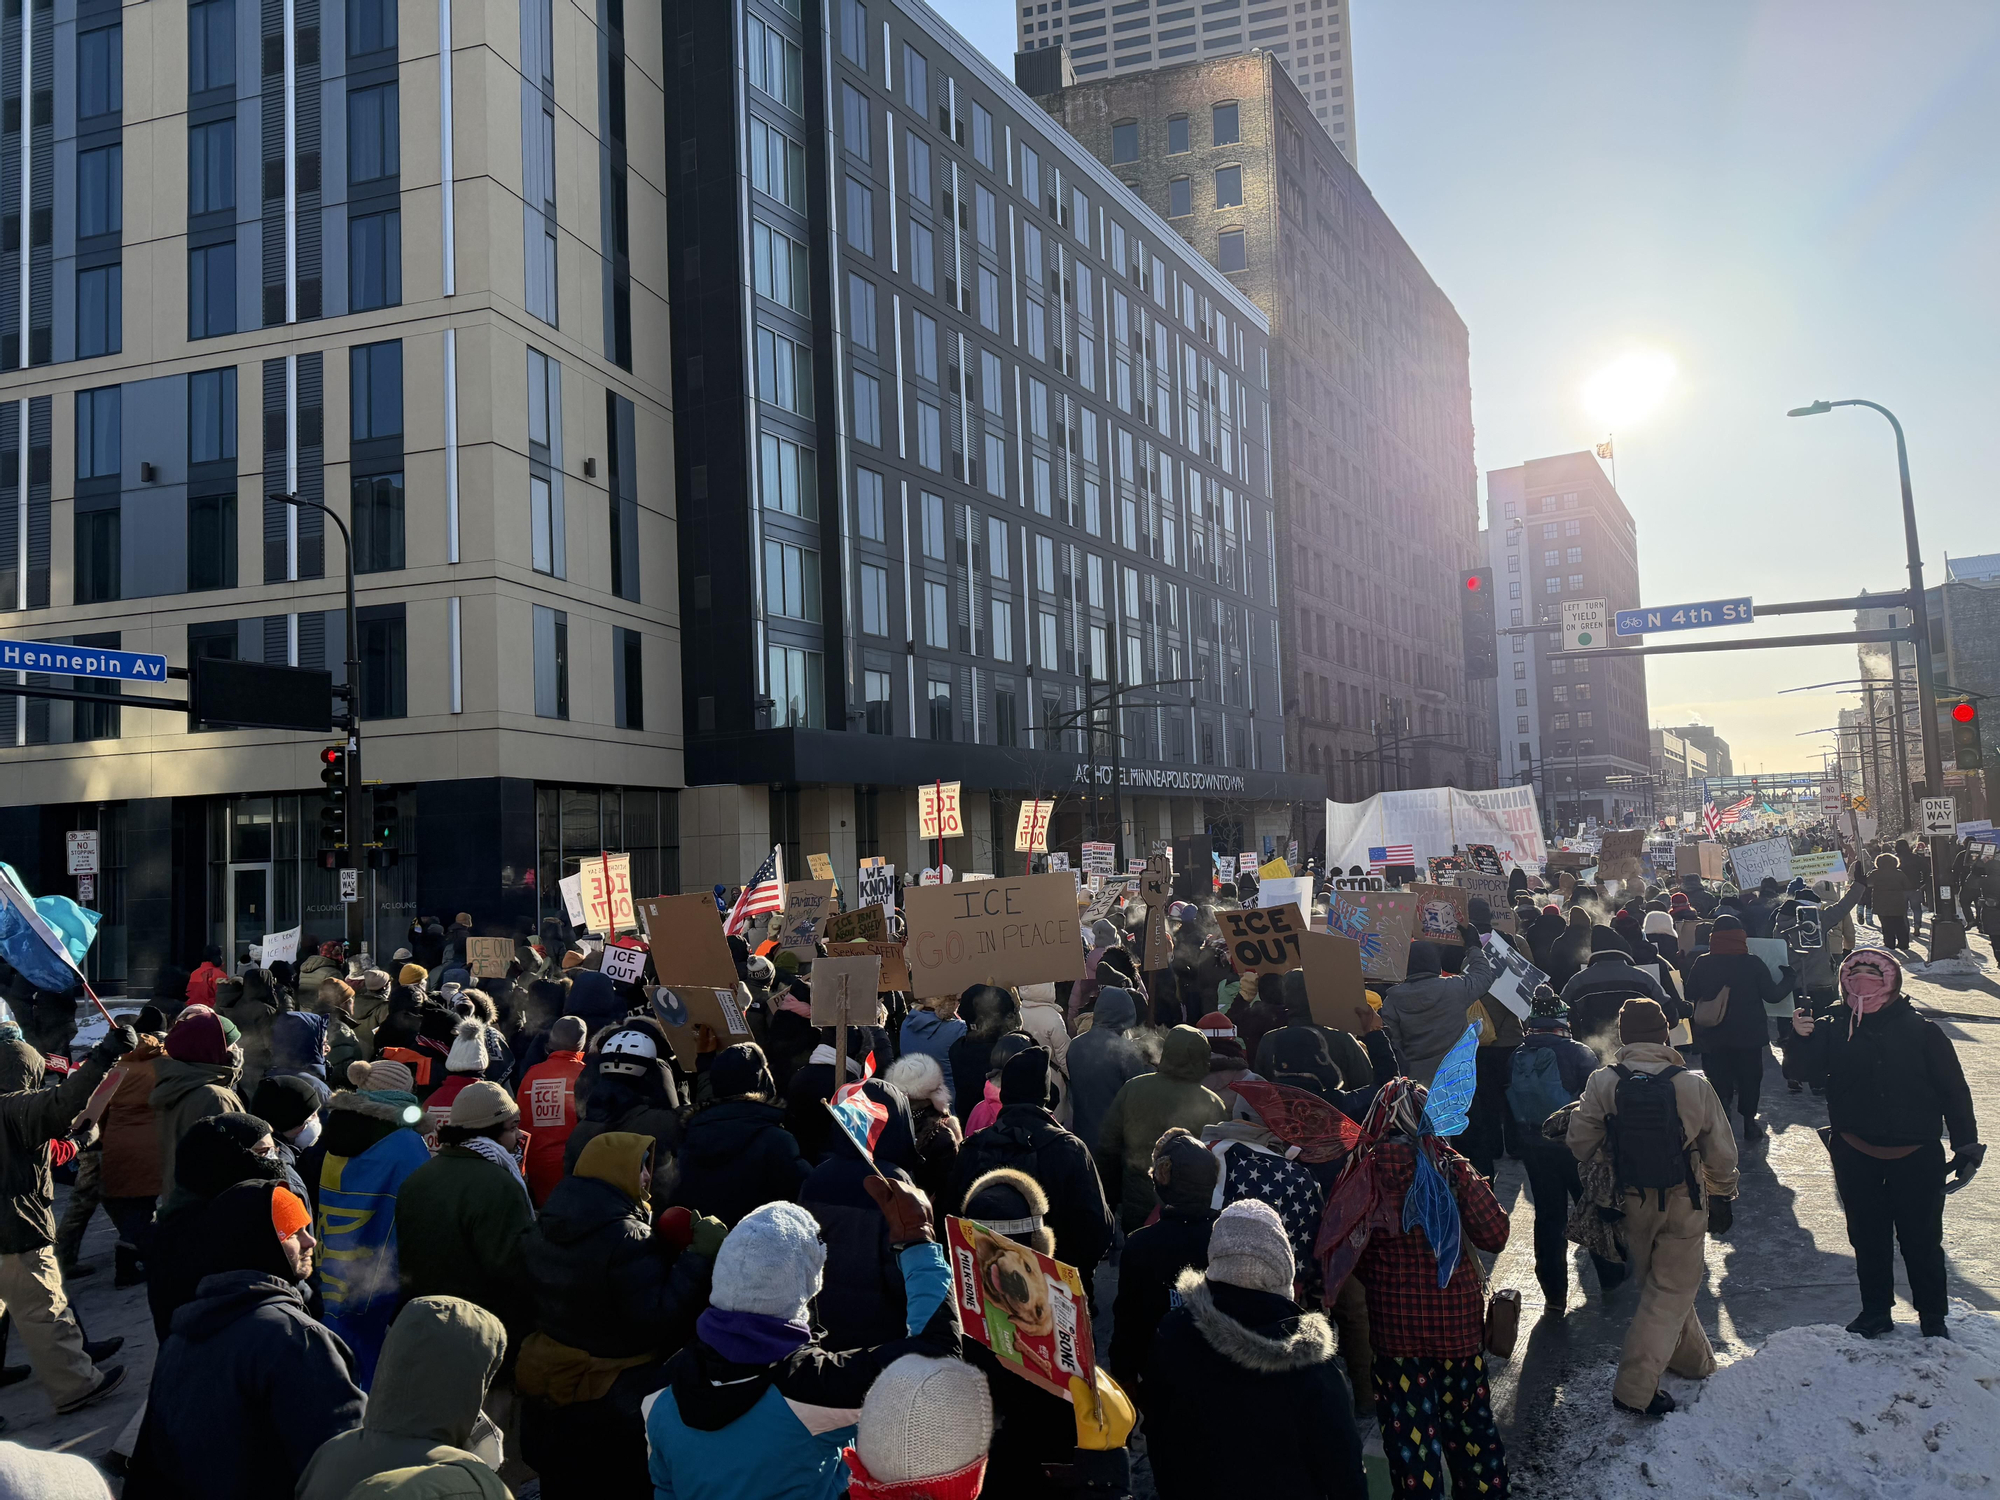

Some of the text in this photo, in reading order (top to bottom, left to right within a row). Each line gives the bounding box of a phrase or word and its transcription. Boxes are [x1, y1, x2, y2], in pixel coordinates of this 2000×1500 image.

[1564, 601, 1604, 612] LEFT TURN
[1572, 612, 1597, 621] YIELD
[1648, 603, 1747, 628] N 4th St
[1566, 621, 1603, 631] ON GREEN
[4, 646, 161, 676] Hennepin Av
[1095, 765, 1129, 786] HOEL
[1130, 768, 1190, 789] MINNEAPOLIS
[1191, 772, 1245, 792] DOWNTOWN
[1826, 786, 1835, 794] NO
[1925, 801, 1951, 810] ONE
[1926, 811, 1952, 820] WAY
[1733, 838, 1788, 860] Leave My
[1736, 854, 1788, 875] Neighbors
[342, 872, 355, 880] ONE
[865, 866, 885, 879] WE
[1741, 868, 1775, 889] Alo!
[342, 881, 356, 889] WAY
[860, 876, 895, 898] KNOW
[1467, 878, 1508, 890] SUPPORT
[865, 895, 890, 906] WHAT
[1335, 894, 1358, 920] KEEP
[833, 915, 853, 930] ICE
[1227, 907, 1292, 936] ICE
[1491, 911, 1511, 920] RIME
[784, 934, 819, 946] TOGETHER
[976, 930, 996, 954] IN
[1003, 920, 1070, 950] PEACE
[471, 939, 512, 958] ICE OUT
[867, 944, 900, 959] SAFETY
[1235, 934, 1301, 967] OUT
[613, 950, 636, 964] ICE
[607, 965, 636, 979] OUT
[535, 1091, 558, 1103] ICE
[536, 1105, 560, 1117] OUT!
[428, 1135, 440, 1148] OU
[960, 1252, 976, 1309] MILK-BONE
